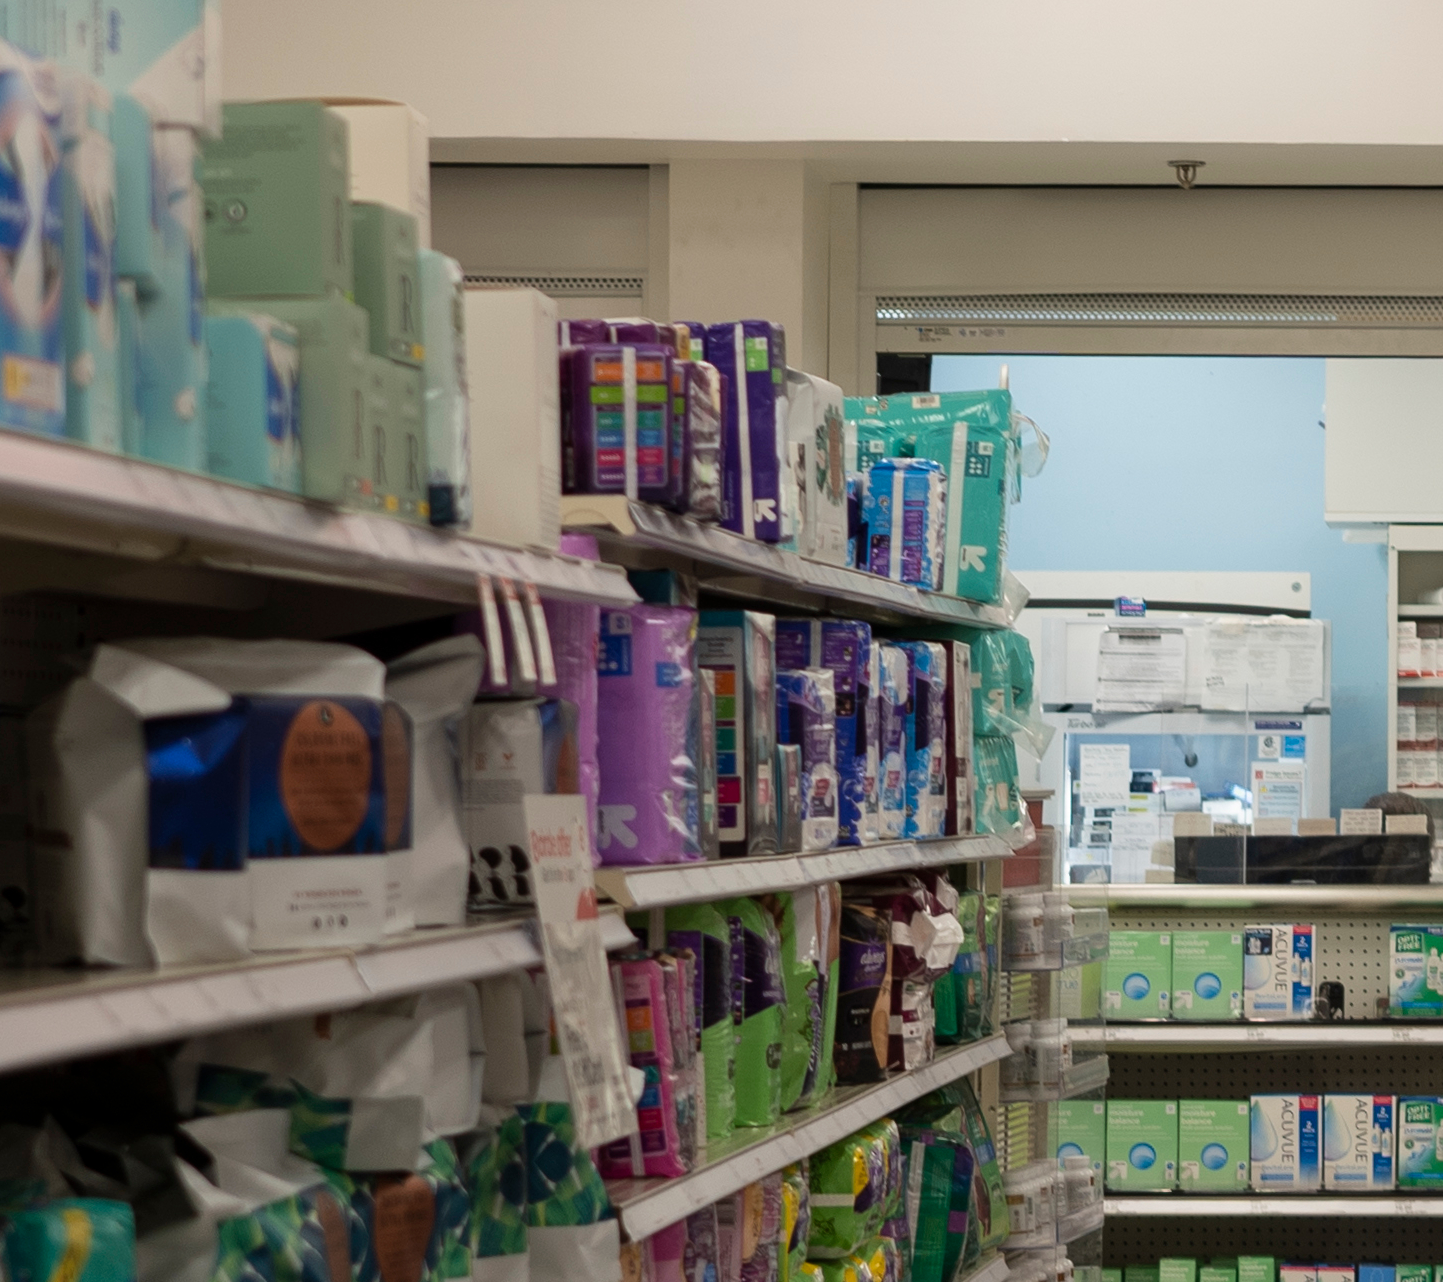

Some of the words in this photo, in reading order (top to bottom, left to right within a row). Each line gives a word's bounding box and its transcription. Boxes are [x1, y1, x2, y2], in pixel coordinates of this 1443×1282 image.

[1274, 928, 1288, 992] ACUVUE
[1281, 1098, 1294, 1163] ACUVUE
[1355, 1098, 1368, 1163] ACUVUE
